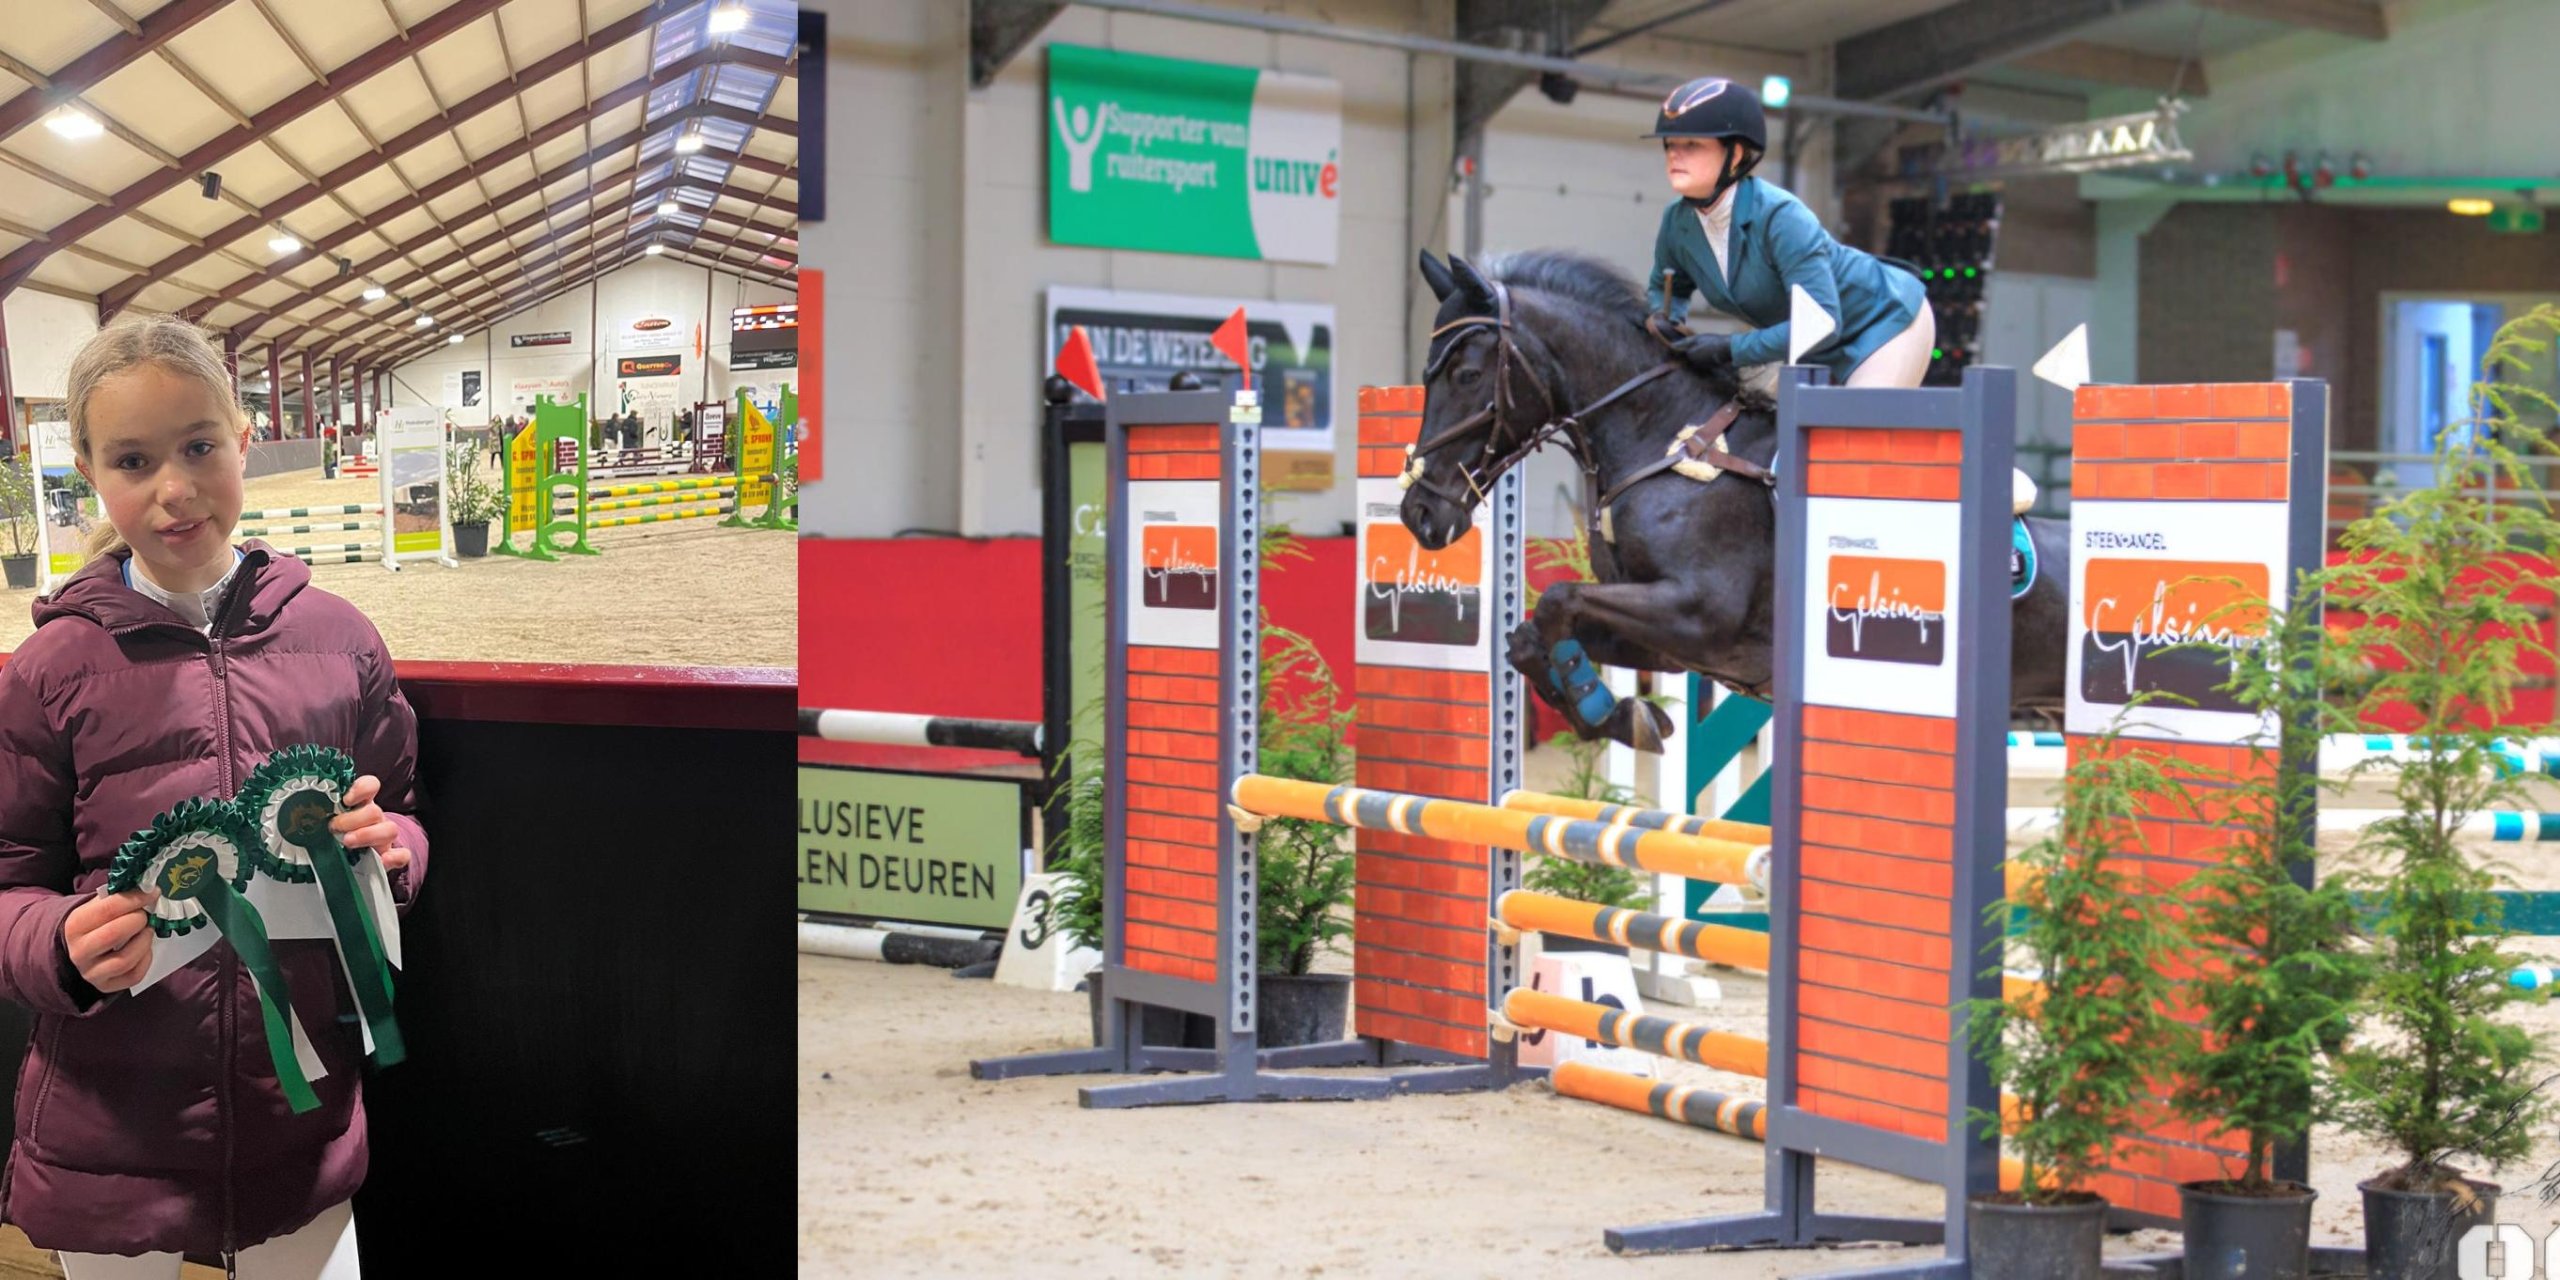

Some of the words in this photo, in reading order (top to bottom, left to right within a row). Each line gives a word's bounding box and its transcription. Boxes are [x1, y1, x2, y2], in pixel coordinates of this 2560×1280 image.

[1107, 102, 1205, 154] Supporter
[1212, 123, 1247, 148] van
[1107, 153, 1217, 193] ruitersport
[1253, 149, 1338, 199] univé
[1115, 327, 1146, 365] DE
[1148, 329, 1267, 371] WETEG
[1371, 542, 1463, 633] Gelsing
[1832, 571, 1928, 652] Gelsing
[2092, 580, 2239, 695] Gelsing
[860, 853, 995, 900] DEUREN
[1021, 889, 1050, 950] 3
